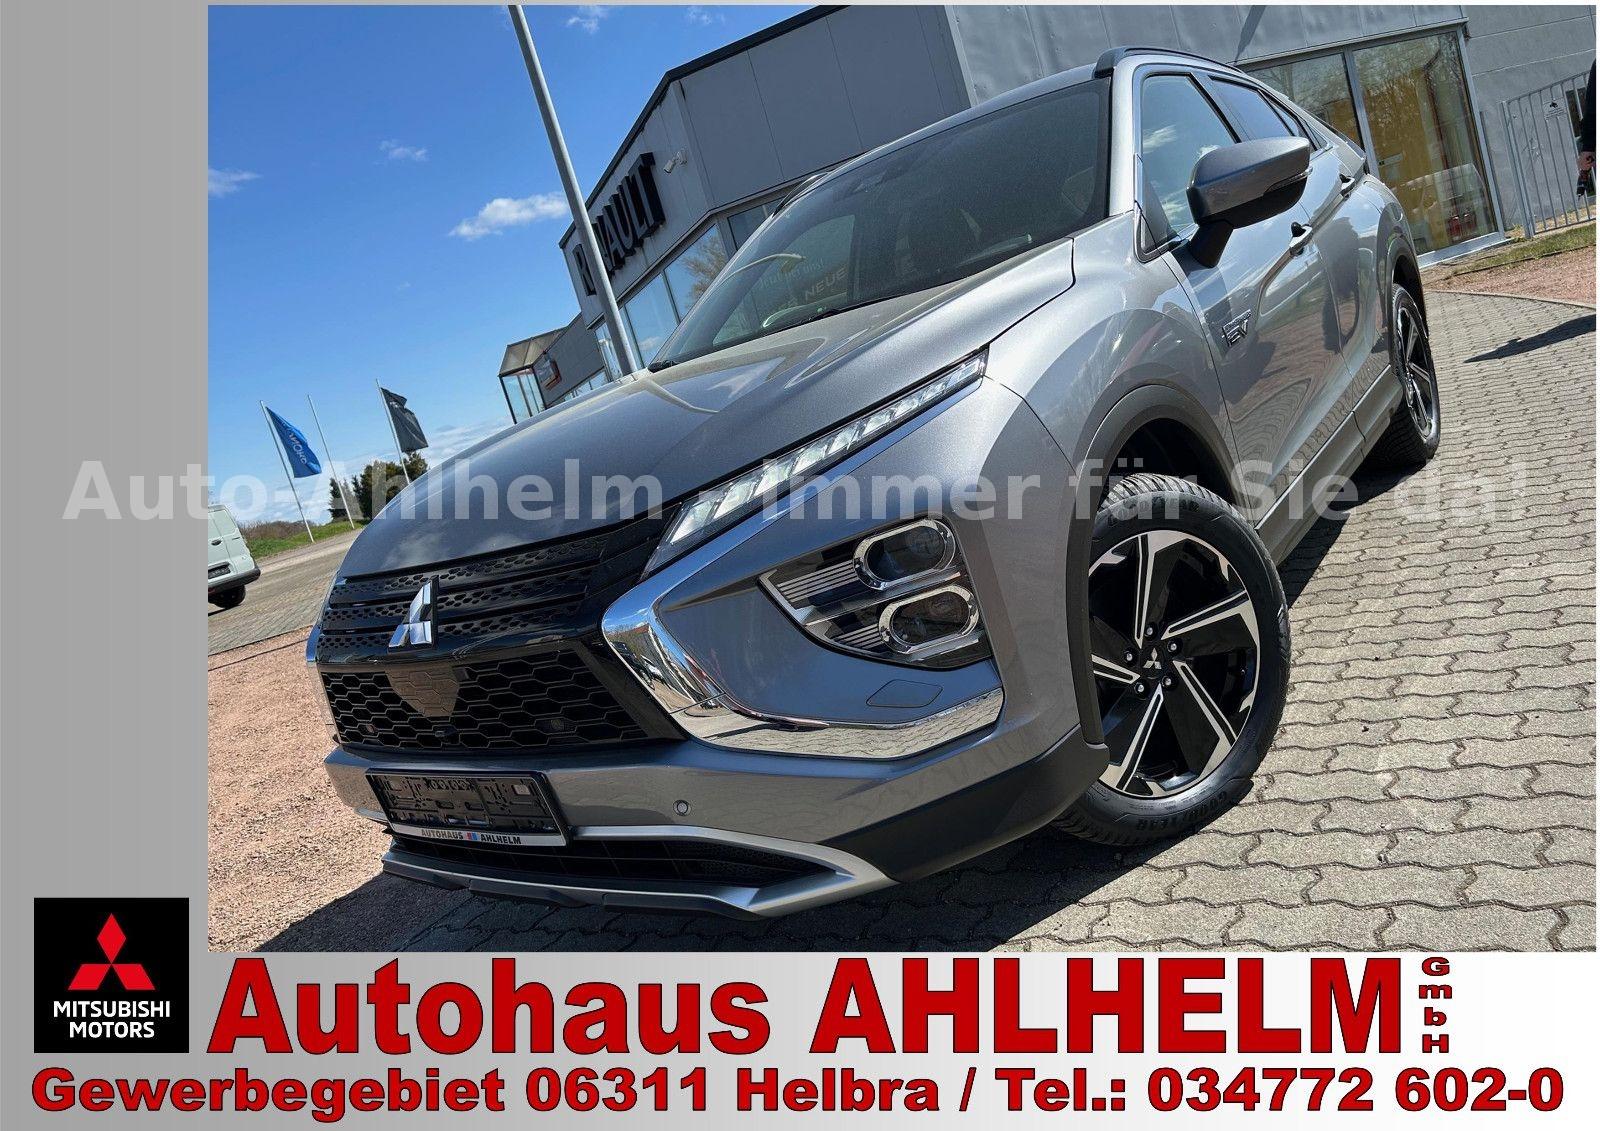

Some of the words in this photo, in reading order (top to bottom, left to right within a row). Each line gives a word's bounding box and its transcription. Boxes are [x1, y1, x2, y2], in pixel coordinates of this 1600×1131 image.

[572, 152, 666, 296] RNAULT
[421, 828, 464, 840] AUTOHAUS
[480, 833, 522, 845] AHLHELM
